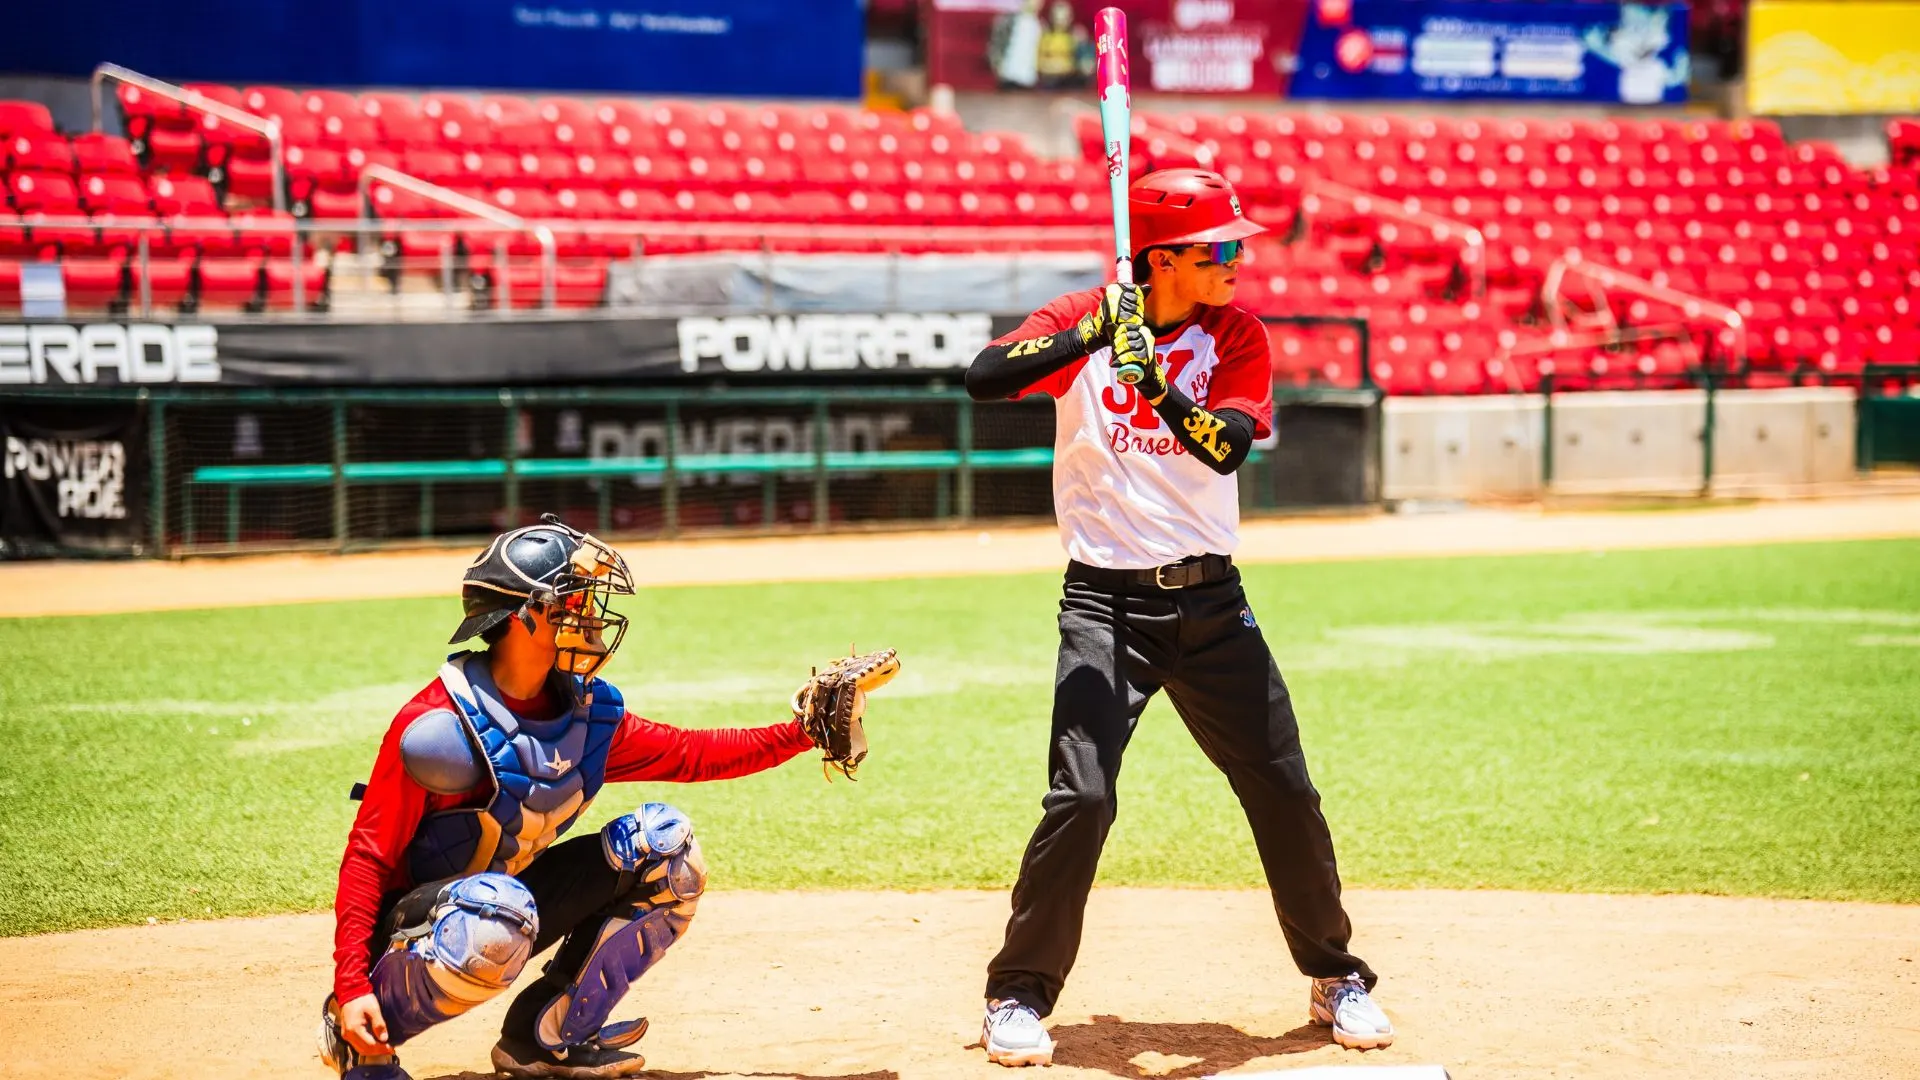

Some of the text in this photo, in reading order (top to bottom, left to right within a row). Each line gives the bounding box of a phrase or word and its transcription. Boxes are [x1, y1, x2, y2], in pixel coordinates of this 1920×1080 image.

[0, 325, 221, 383] ERADE
[678, 314, 991, 371] POWERADE
[4, 436, 125, 485] POWER
[1183, 406, 1227, 463] 3K
